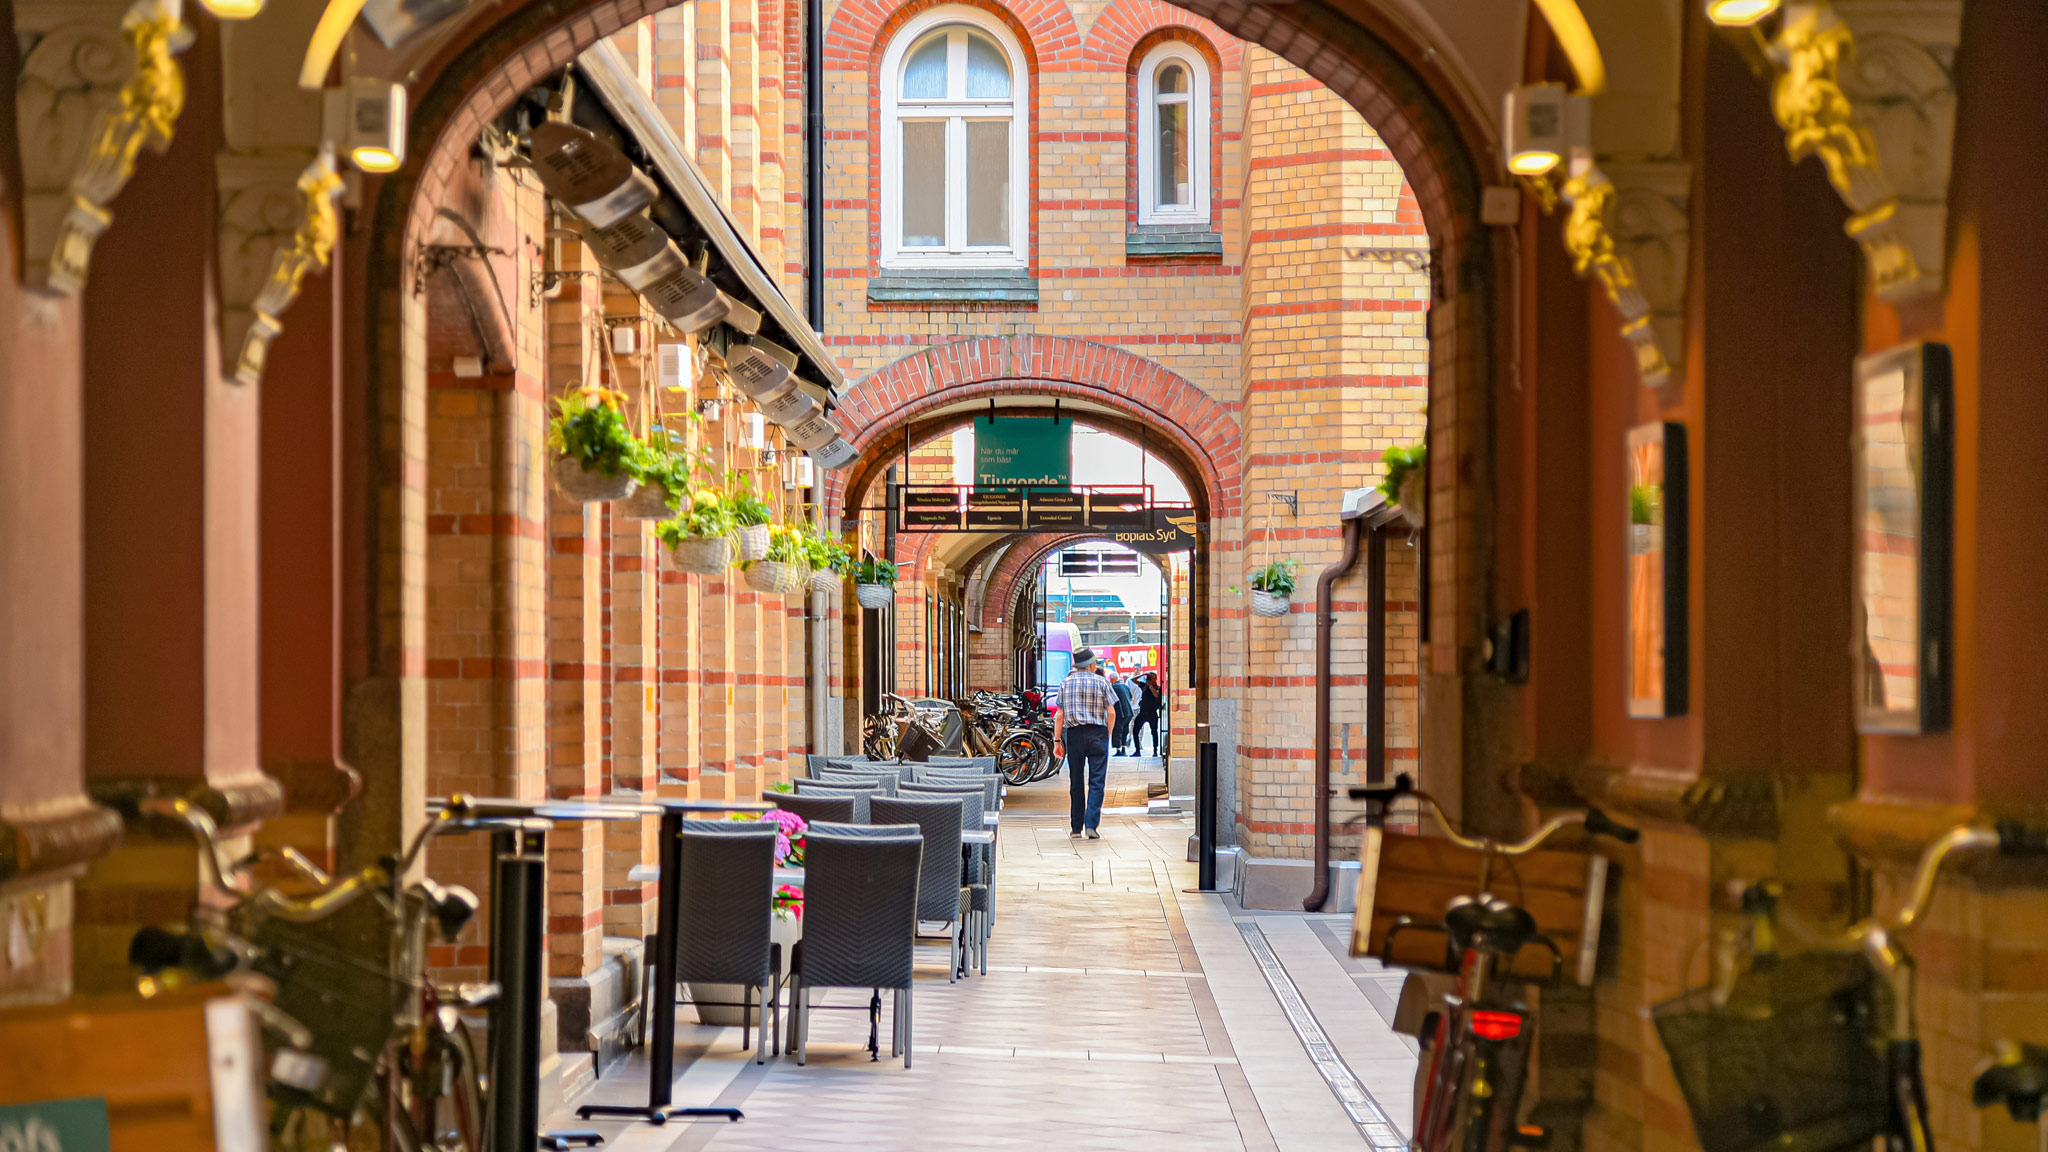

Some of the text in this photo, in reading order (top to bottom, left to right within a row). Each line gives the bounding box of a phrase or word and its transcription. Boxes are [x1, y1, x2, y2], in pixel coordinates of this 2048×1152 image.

[980, 447, 1019, 455] När du mår
[1115, 529, 1176, 543] Boplats Syd
